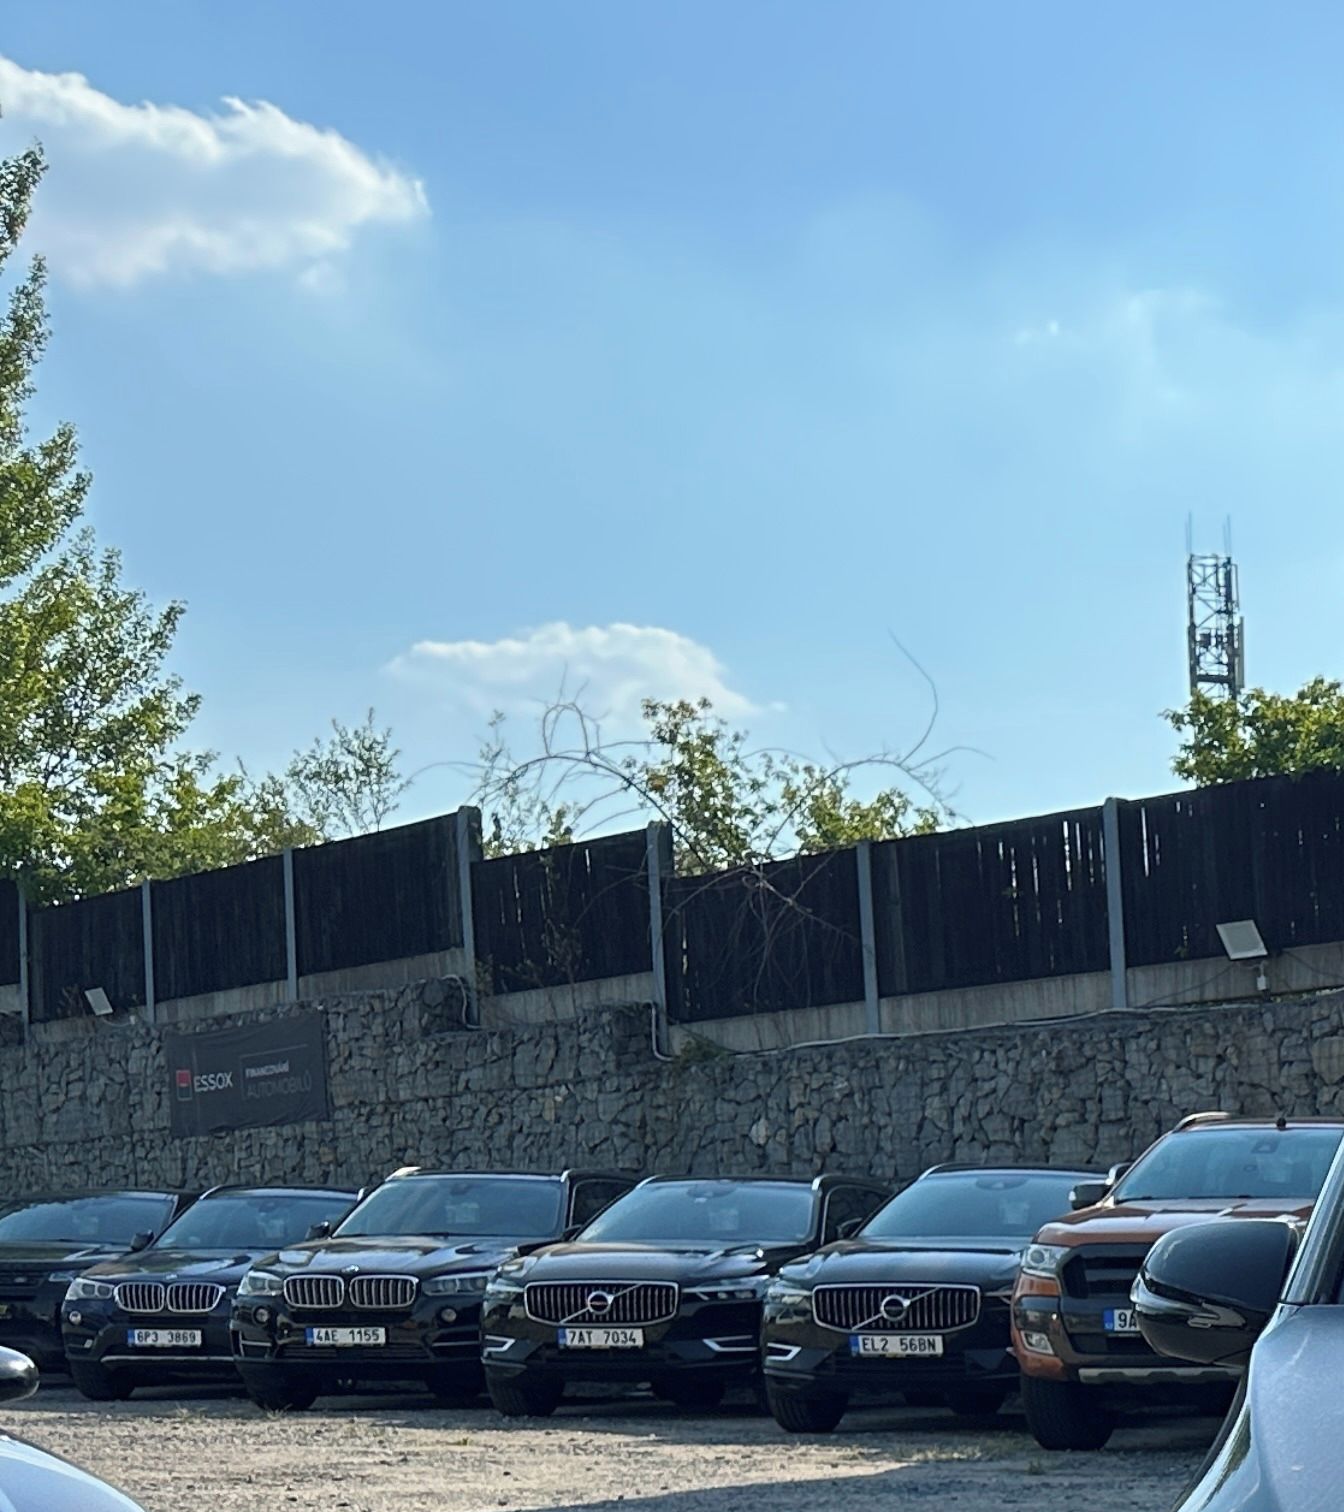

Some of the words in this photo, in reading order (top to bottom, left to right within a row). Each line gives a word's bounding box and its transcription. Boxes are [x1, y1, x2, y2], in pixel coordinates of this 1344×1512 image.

[193, 1071, 234, 1093] ESSOX
[315, 1328, 339, 1342] 4AE
[348, 1328, 380, 1342] 1155
[568, 1330, 593, 1345] 7AT
[603, 1330, 637, 1345] 7034
[861, 1336, 889, 1352] EL2
[899, 1337, 937, 1353] 56BN
